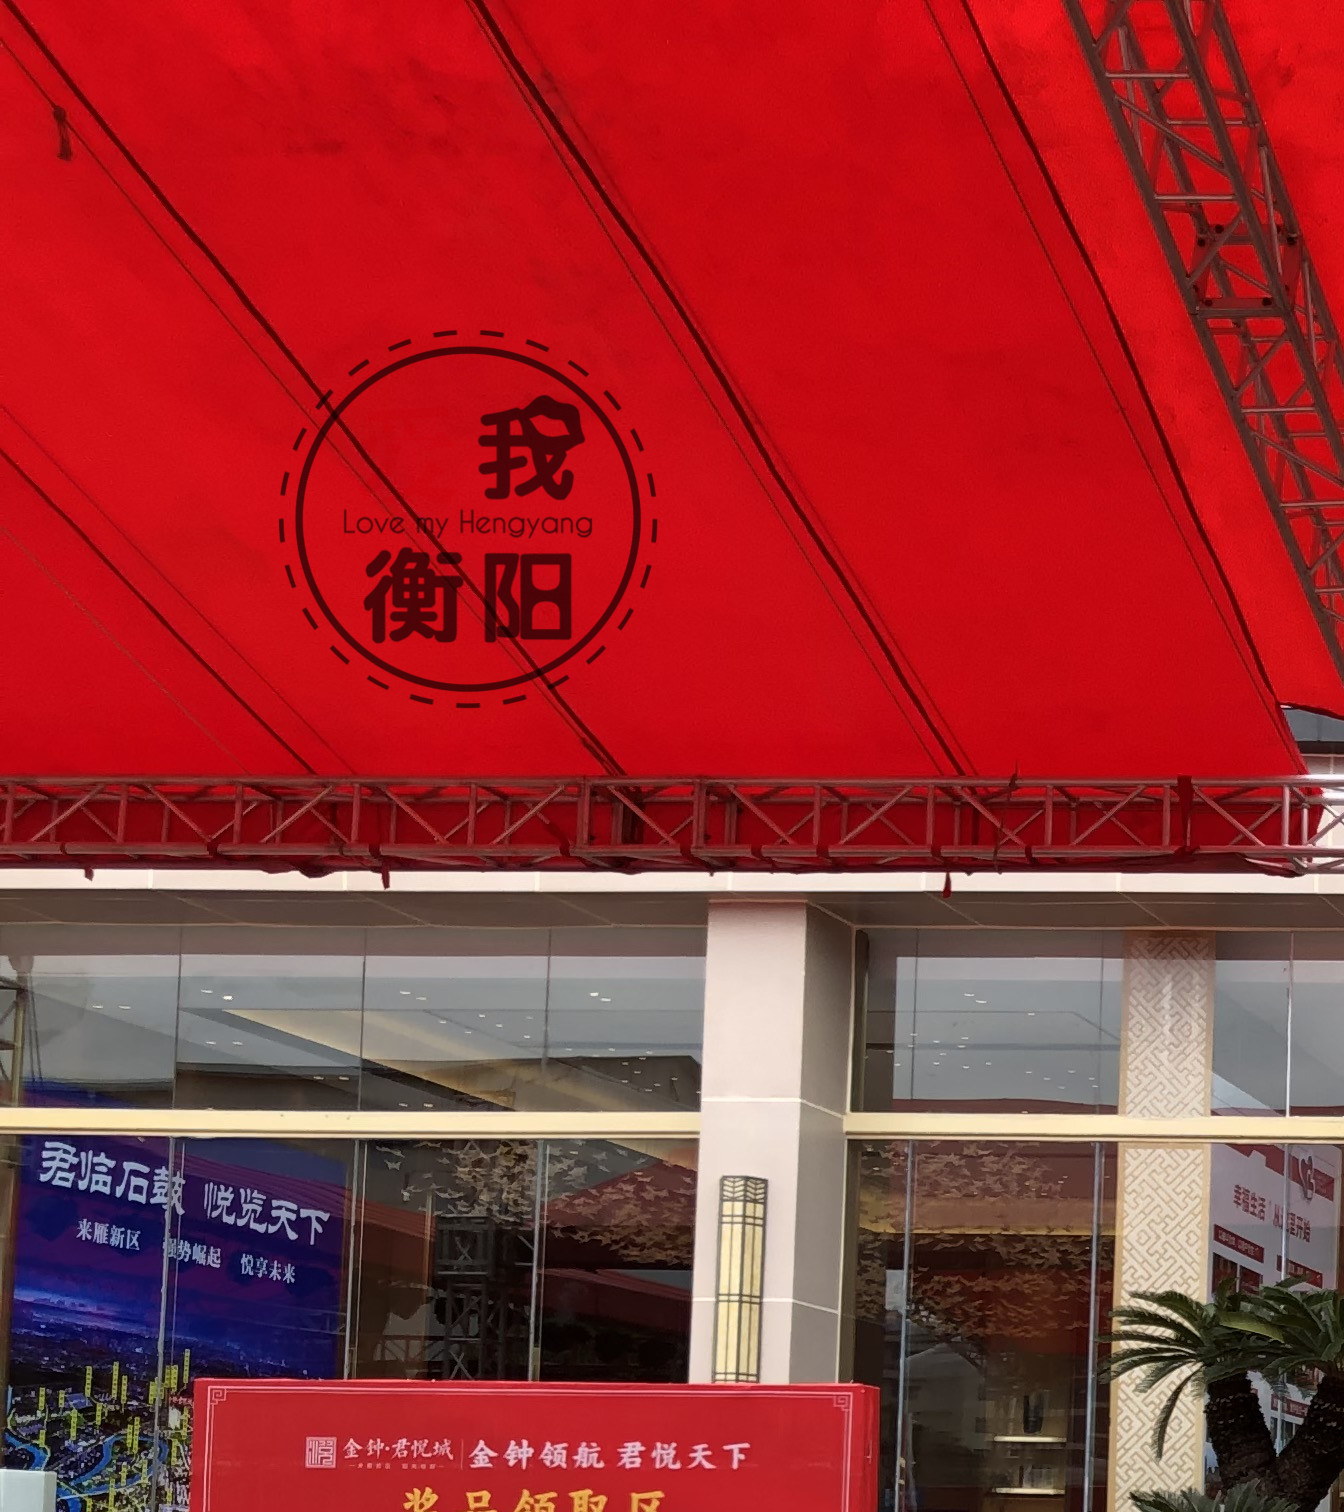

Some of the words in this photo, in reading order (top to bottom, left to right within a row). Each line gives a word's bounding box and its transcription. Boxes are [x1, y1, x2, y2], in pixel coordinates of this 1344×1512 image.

[39, 1140, 186, 1216] 君临石鼓
[203, 1181, 330, 1246] 悦览天下
[75, 1218, 141, 1251] 来雁新区
[162, 1238, 222, 1269] 强势崛起
[240, 1253, 296, 1284] 悦享未来
[468, 1438, 606, 1470] 金钟领航
[616, 1440, 752, 1471] 君悦天下
